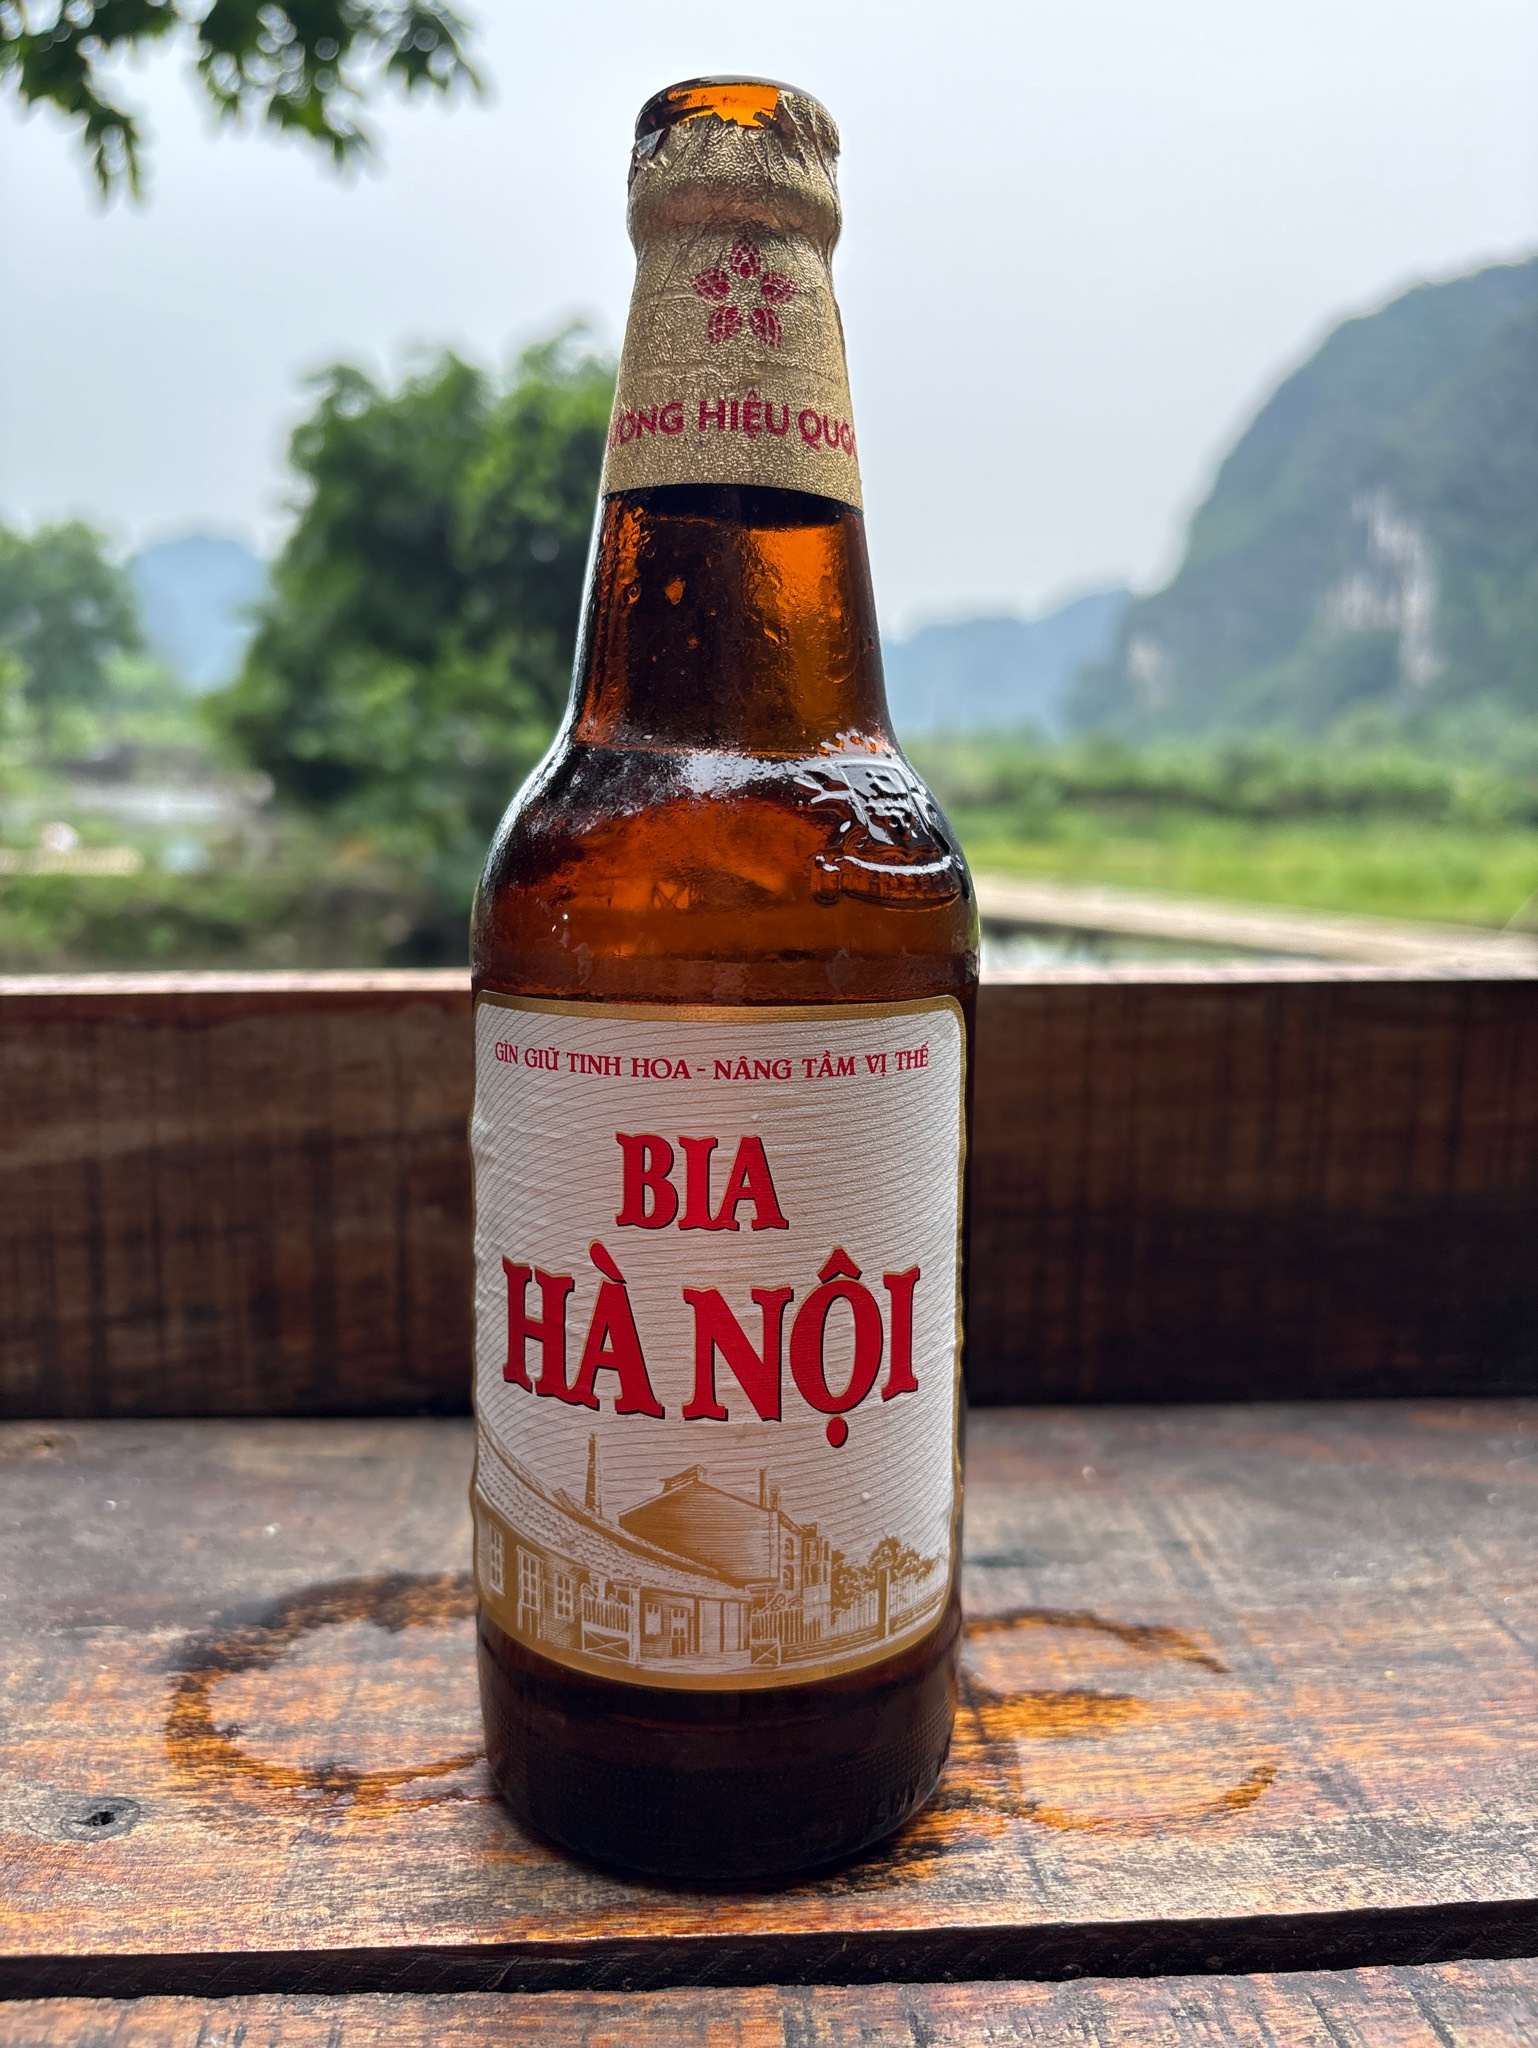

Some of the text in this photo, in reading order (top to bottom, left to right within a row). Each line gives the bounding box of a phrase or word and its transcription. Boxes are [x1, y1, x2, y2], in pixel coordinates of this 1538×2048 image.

[697, 390, 789, 438] HIỆU
[495, 1040, 518, 1065] GÌN
[524, 1047, 560, 1071] GIỮ
[567, 1052, 622, 1077] TINH
[631, 1057, 692, 1080] HOA
[713, 1055, 792, 1080] NÂNG
[802, 1050, 856, 1079] TẦM
[865, 1053, 887, 1078] VỊ
[895, 1041, 929, 1071] THẾ
[615, 1132, 789, 1231] BIA
[502, 1239, 920, 1448] HÀ NỘI
